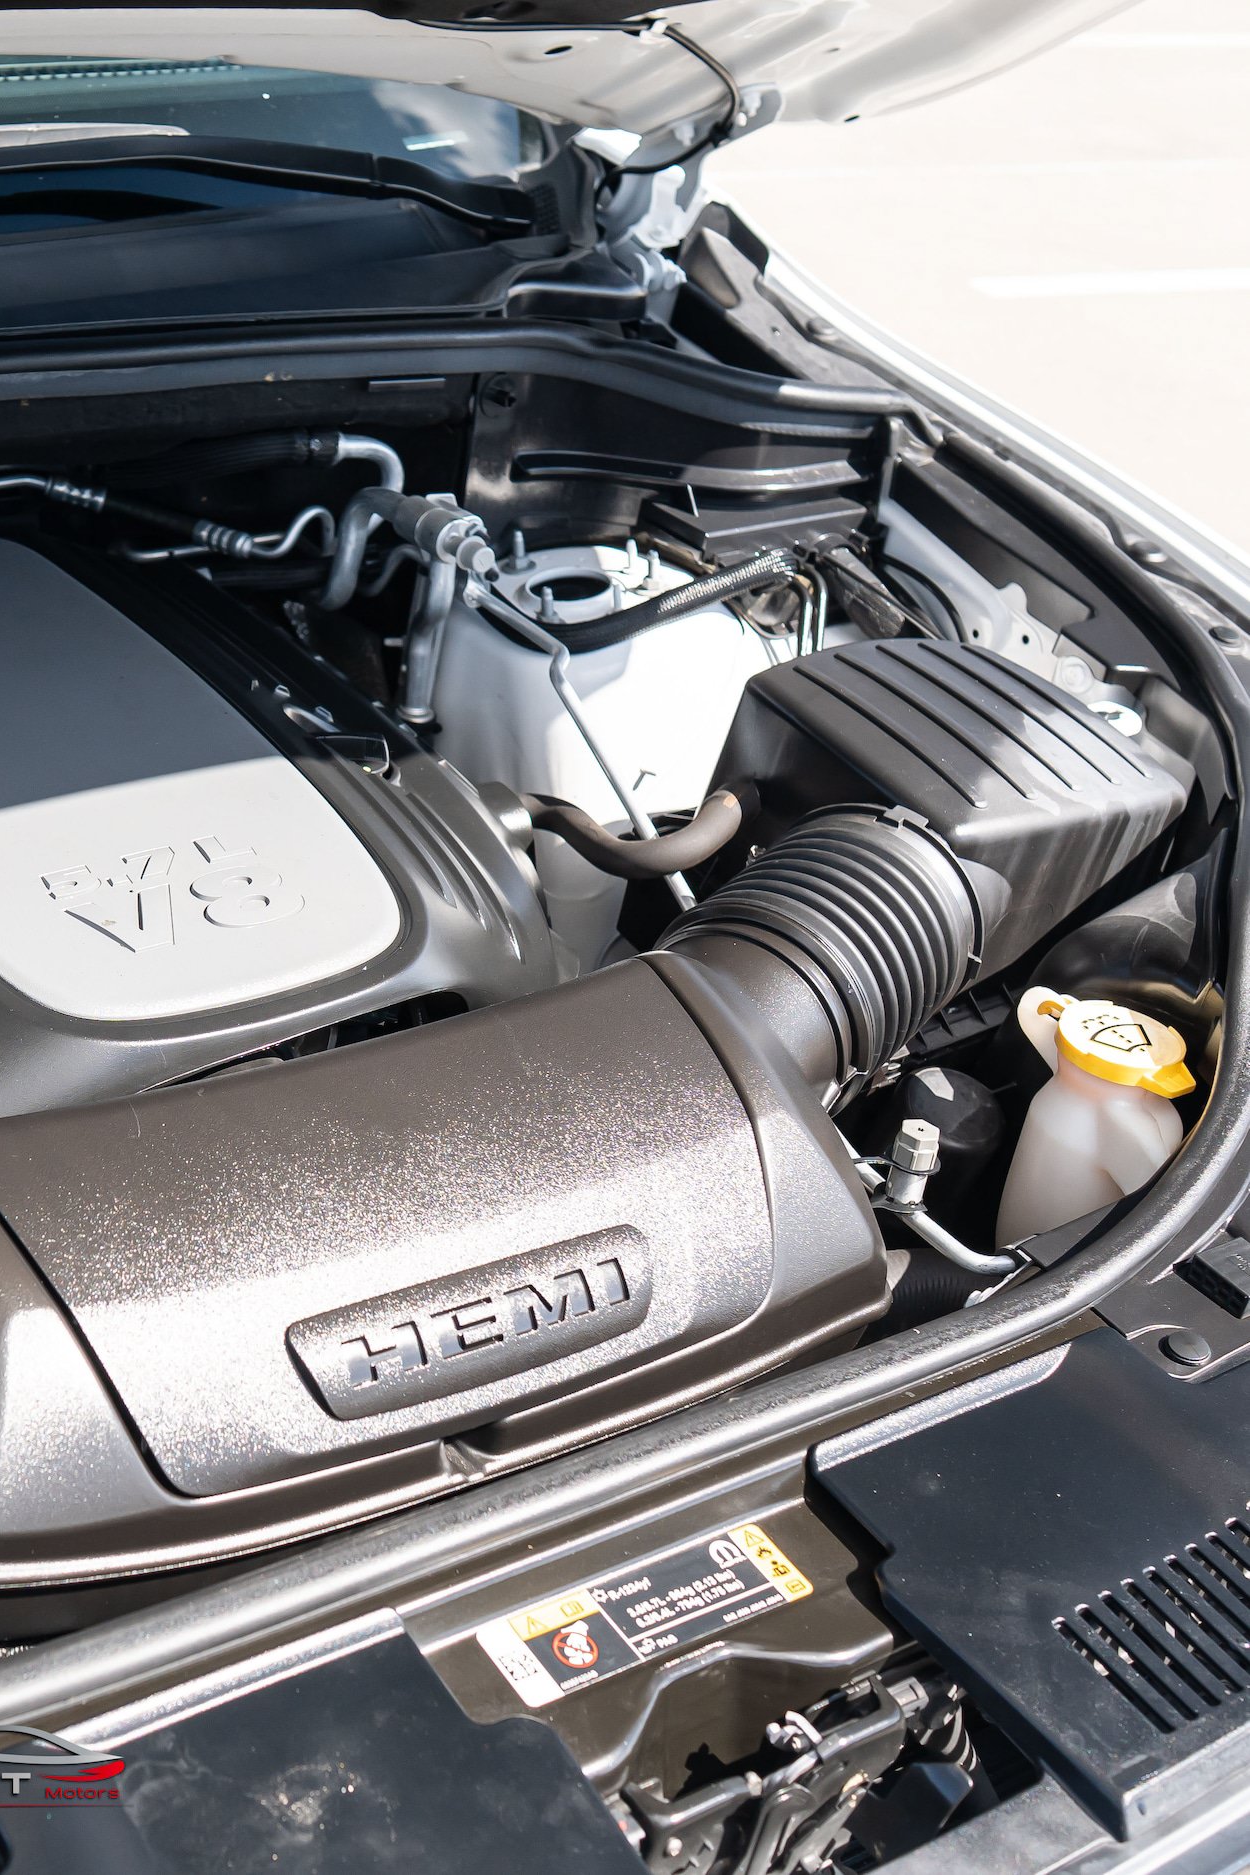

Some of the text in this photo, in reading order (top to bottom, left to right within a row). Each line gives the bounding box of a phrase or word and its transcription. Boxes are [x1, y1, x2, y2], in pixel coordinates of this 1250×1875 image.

[38, 834, 258, 900] 5.7L
[62, 864, 306, 954] V8
[341, 1256, 631, 1390] HEMI
